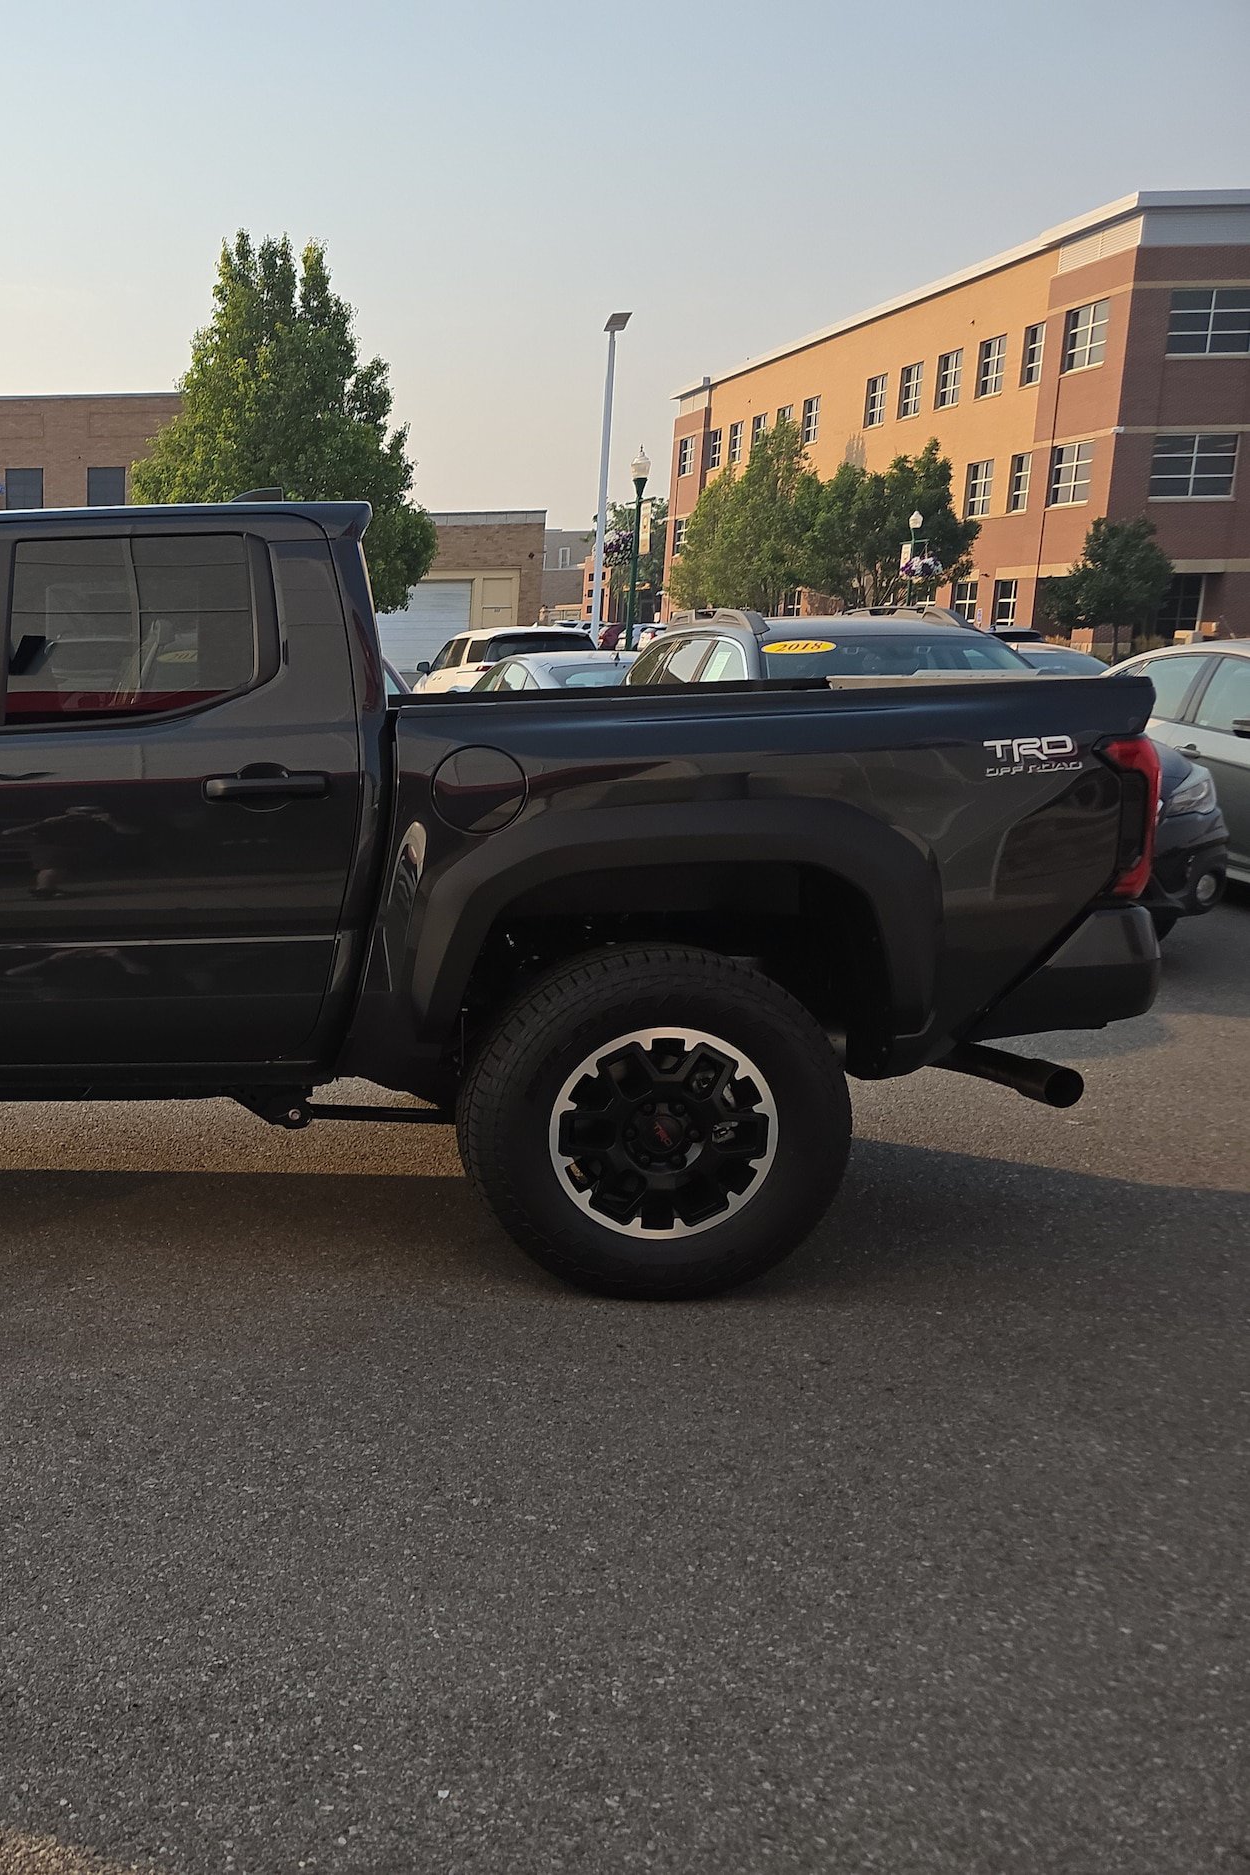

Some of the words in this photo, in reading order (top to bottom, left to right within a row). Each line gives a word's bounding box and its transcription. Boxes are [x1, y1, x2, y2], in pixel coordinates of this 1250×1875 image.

[774, 642, 823, 653] 2018
[982, 734, 1074, 763] TRD
[985, 764, 1024, 777] OFF
[1026, 760, 1083, 774] ROAD
